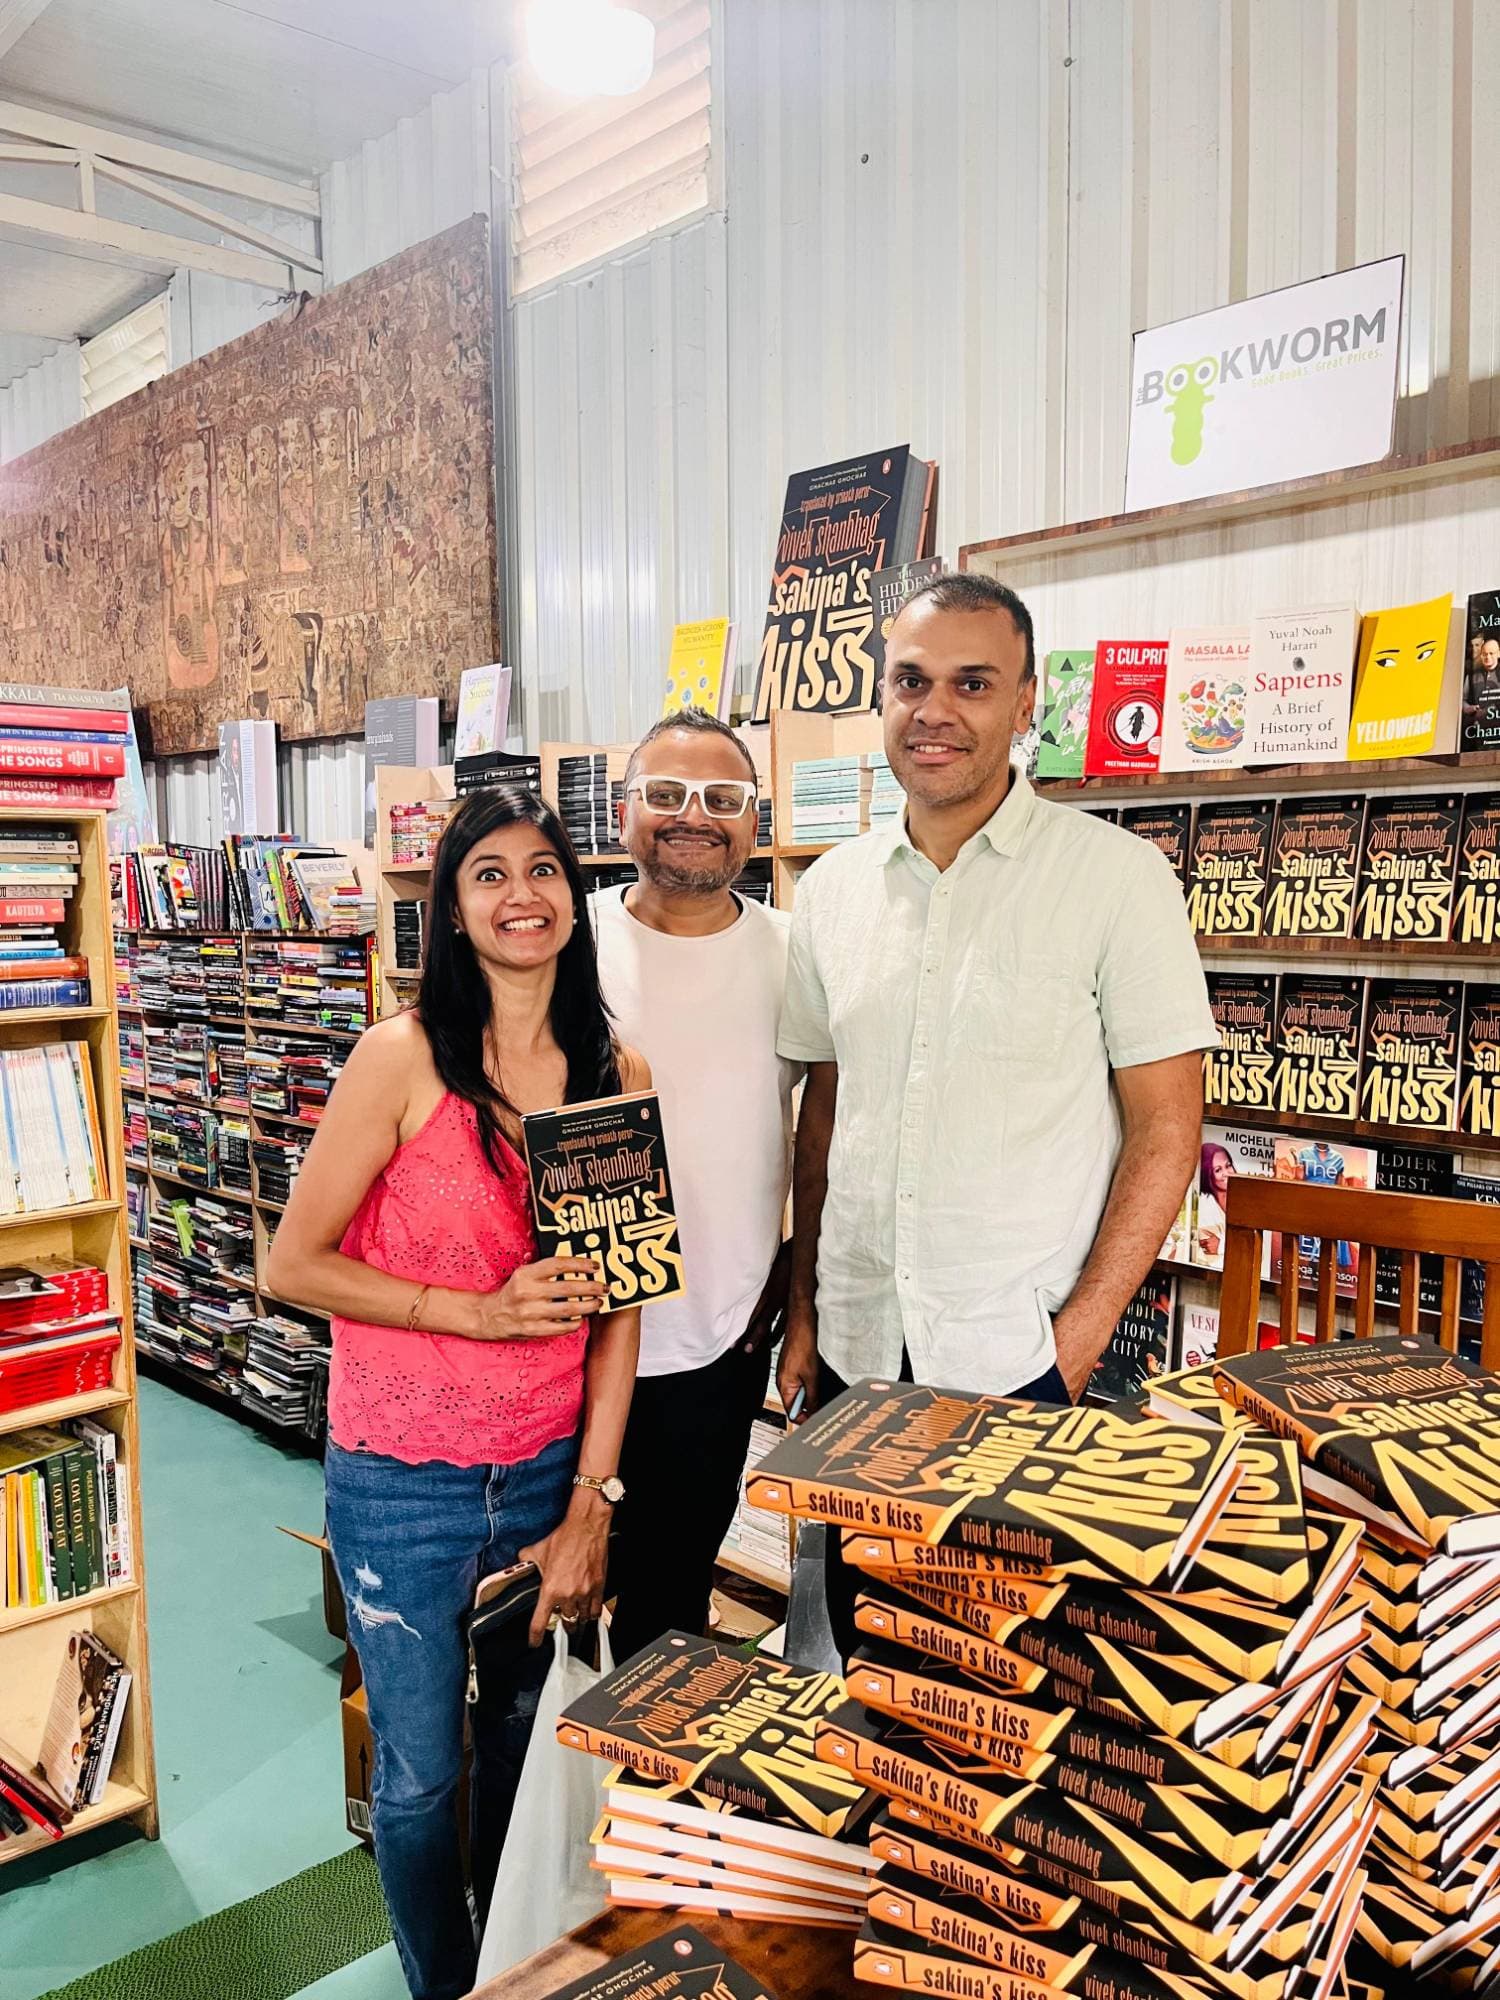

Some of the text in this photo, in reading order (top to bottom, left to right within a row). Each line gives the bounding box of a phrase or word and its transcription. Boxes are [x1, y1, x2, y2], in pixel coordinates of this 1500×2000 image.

[1315, 357, 1343, 371] Great
[779, 510, 880, 564] vivek shanbhag
[771, 560, 872, 617] sakina's
[1105, 648, 1115, 665] 3
[1184, 645, 1235, 656] MASALA
[1269, 625, 1333, 640] Yuval Noah
[1282, 641, 1318, 652] Harari
[754, 618, 875, 721] kiss
[1254, 672, 1343, 697] Sapiens
[1260, 718, 1335, 737] History of
[1272, 700, 1324, 716] A Brief
[1356, 710, 1435, 745] YELLOWFACE
[16, 756, 63, 768] SONGS
[1254, 737, 1338, 753] Humankind
[1196, 856, 1258, 880] sakina's
[1280, 852, 1347, 878] sakina's
[1370, 854, 1443, 881] sakina's
[1188, 881, 1263, 936] kiss
[1265, 880, 1351, 936] kiss
[1355, 882, 1449, 941] kiss
[1222, 1028, 1267, 1053] kina's
[1285, 1032, 1349, 1059] sakina's
[1375, 1038, 1446, 1066] sakina's
[1203, 1052, 1274, 1108] kiss
[1273, 1057, 1358, 1118] kiss
[1361, 1066, 1454, 1130] kiss
[546, 1146, 652, 1193] vivek shanbhag
[1305, 1159, 1338, 1179] The
[554, 1185, 658, 1235] sakina's
[1113, 1339, 1141, 1359] CITY
[940, 1409, 1059, 1497] sakina's
[53, 1483, 67, 1548] LOVE TO EAT
[70, 1478, 85, 1543] LOVE TO EAT
[808, 1492, 924, 1533] sakina's kiss
[961, 1517, 1053, 1566] vivek shanbhag
[961, 1599, 991, 1634] kiss
[992, 1578, 1028, 1612] kiss
[1065, 1602, 1158, 1651] vivek shanbhag
[911, 1624, 1018, 1682] sakina's kiss
[637, 1700, 697, 1735] vivek
[673, 1655, 760, 1707] shanbhag
[696, 1672, 805, 1755] sakina's
[910, 1687, 986, 1728] sakina's
[992, 1703, 1030, 1741] kiss
[599, 1740, 679, 1782] sakina's kiss
[1069, 1729, 1166, 1785] vivek shanbhag
[871, 1755, 939, 1803] sakina's
[943, 1780, 978, 1820] kiss
[1057, 1763, 1147, 1829] vivek shanbhag
[1014, 1813, 1044, 1848] vivek
[1046, 1826, 1102, 1879] shanbhag
[929, 1859, 1042, 1920] sakina's kiss
[931, 1916, 1047, 1979] sakina's kiss
[1079, 1917, 1168, 1972] vivek shanbhag
[652, 1971, 682, 1997] perur
[923, 1966, 1002, 2000] sakina's
